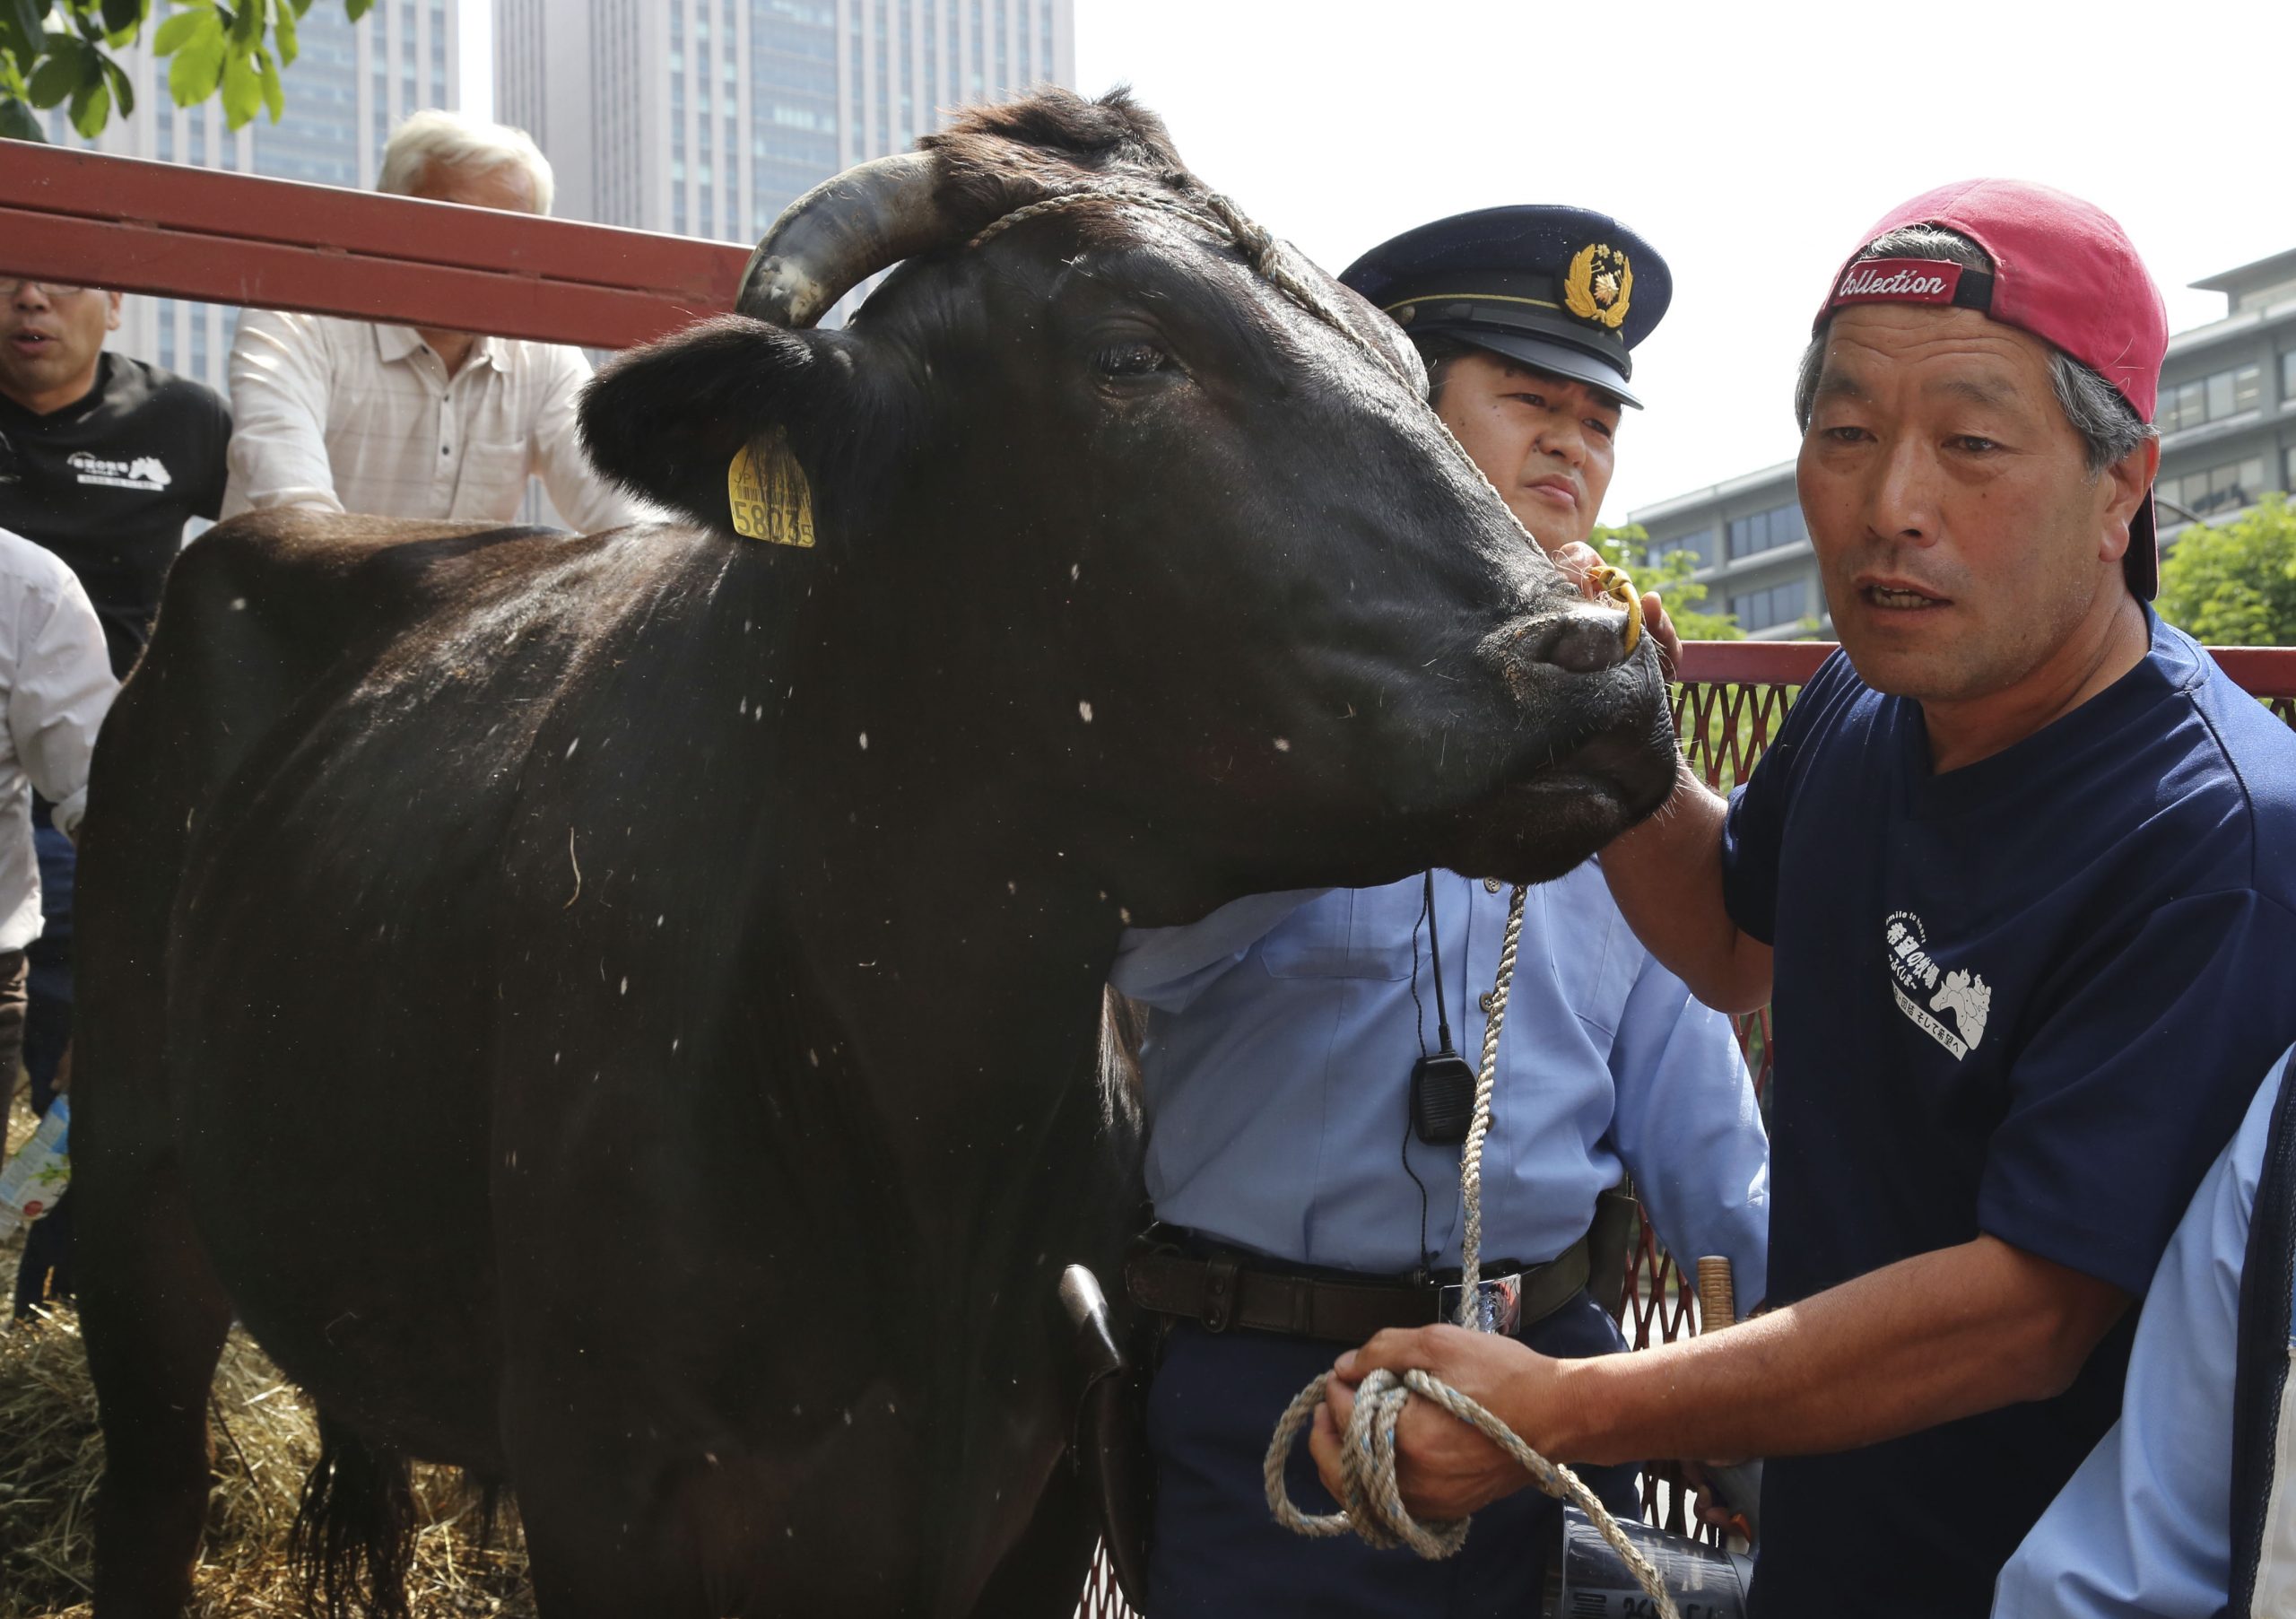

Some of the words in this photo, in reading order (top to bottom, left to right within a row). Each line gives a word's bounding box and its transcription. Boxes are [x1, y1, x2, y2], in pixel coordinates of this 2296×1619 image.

[1839, 269, 1946, 297] Collection
[1909, 911, 1917, 921] to
[1887, 922, 1940, 989] 希望の牧場
[1917, 1012, 1959, 1053] そして希望へ
